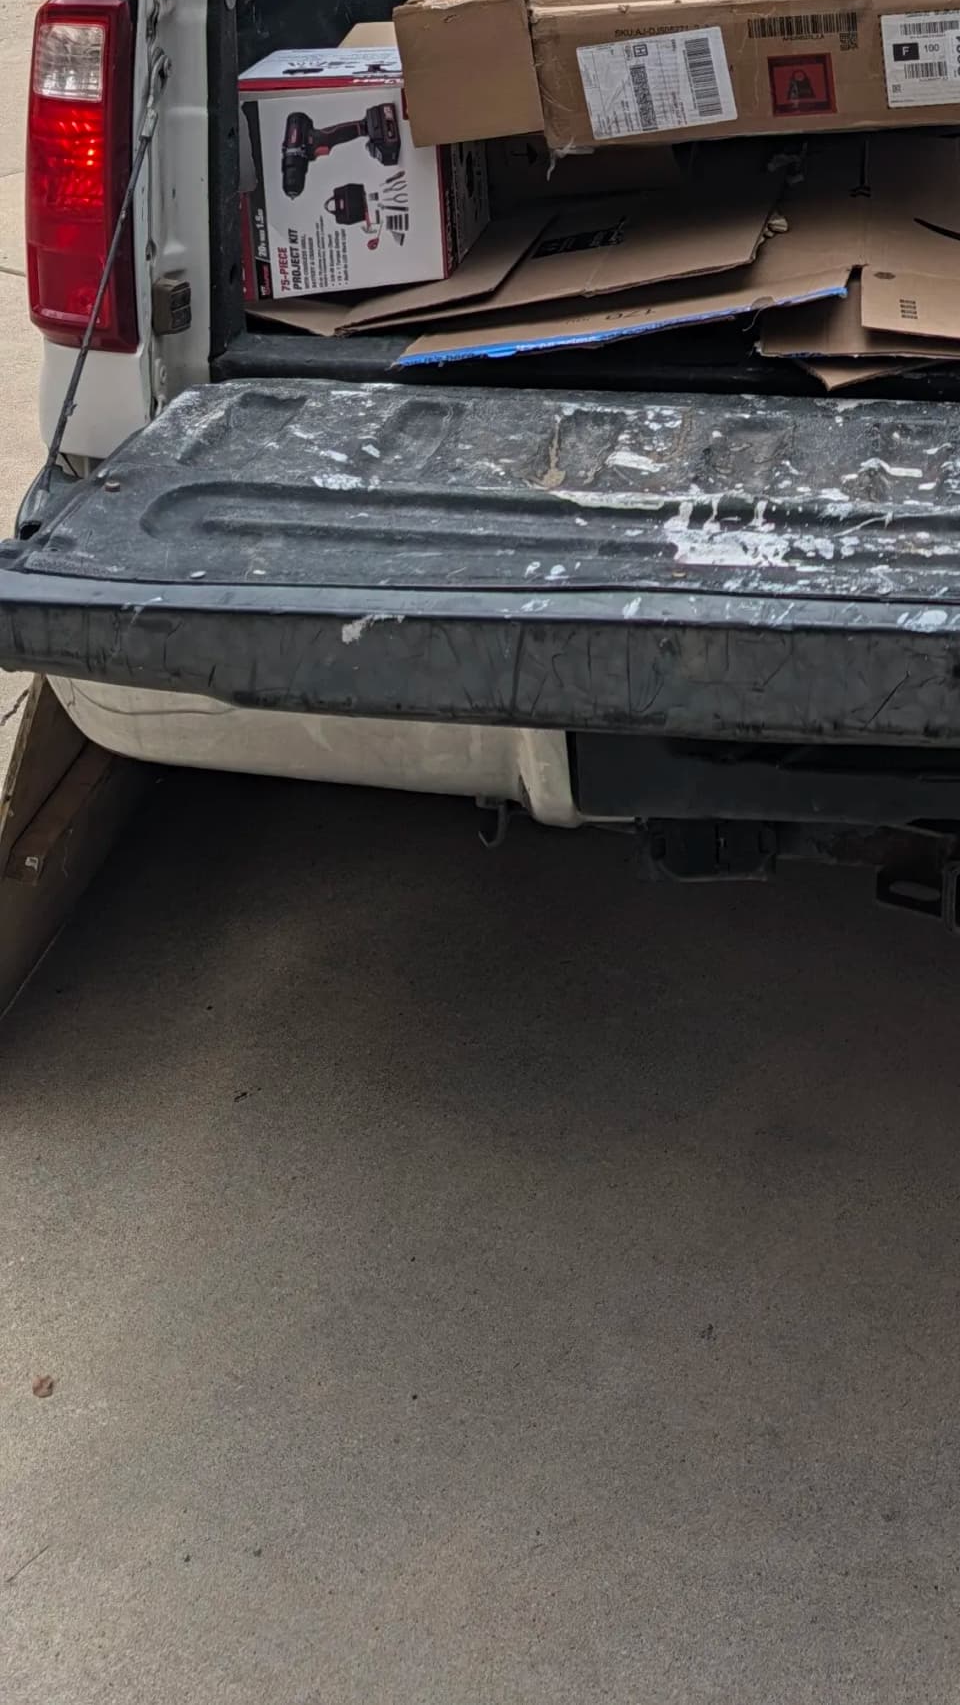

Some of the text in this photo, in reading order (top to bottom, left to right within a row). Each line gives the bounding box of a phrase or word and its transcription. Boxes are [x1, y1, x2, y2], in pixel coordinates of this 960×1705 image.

[902, 47, 910, 56] F
[924, 44, 940, 53] 100
[278, 246, 291, 292] 75-PIECE
[288, 227, 302, 290] PROJECT KIT
